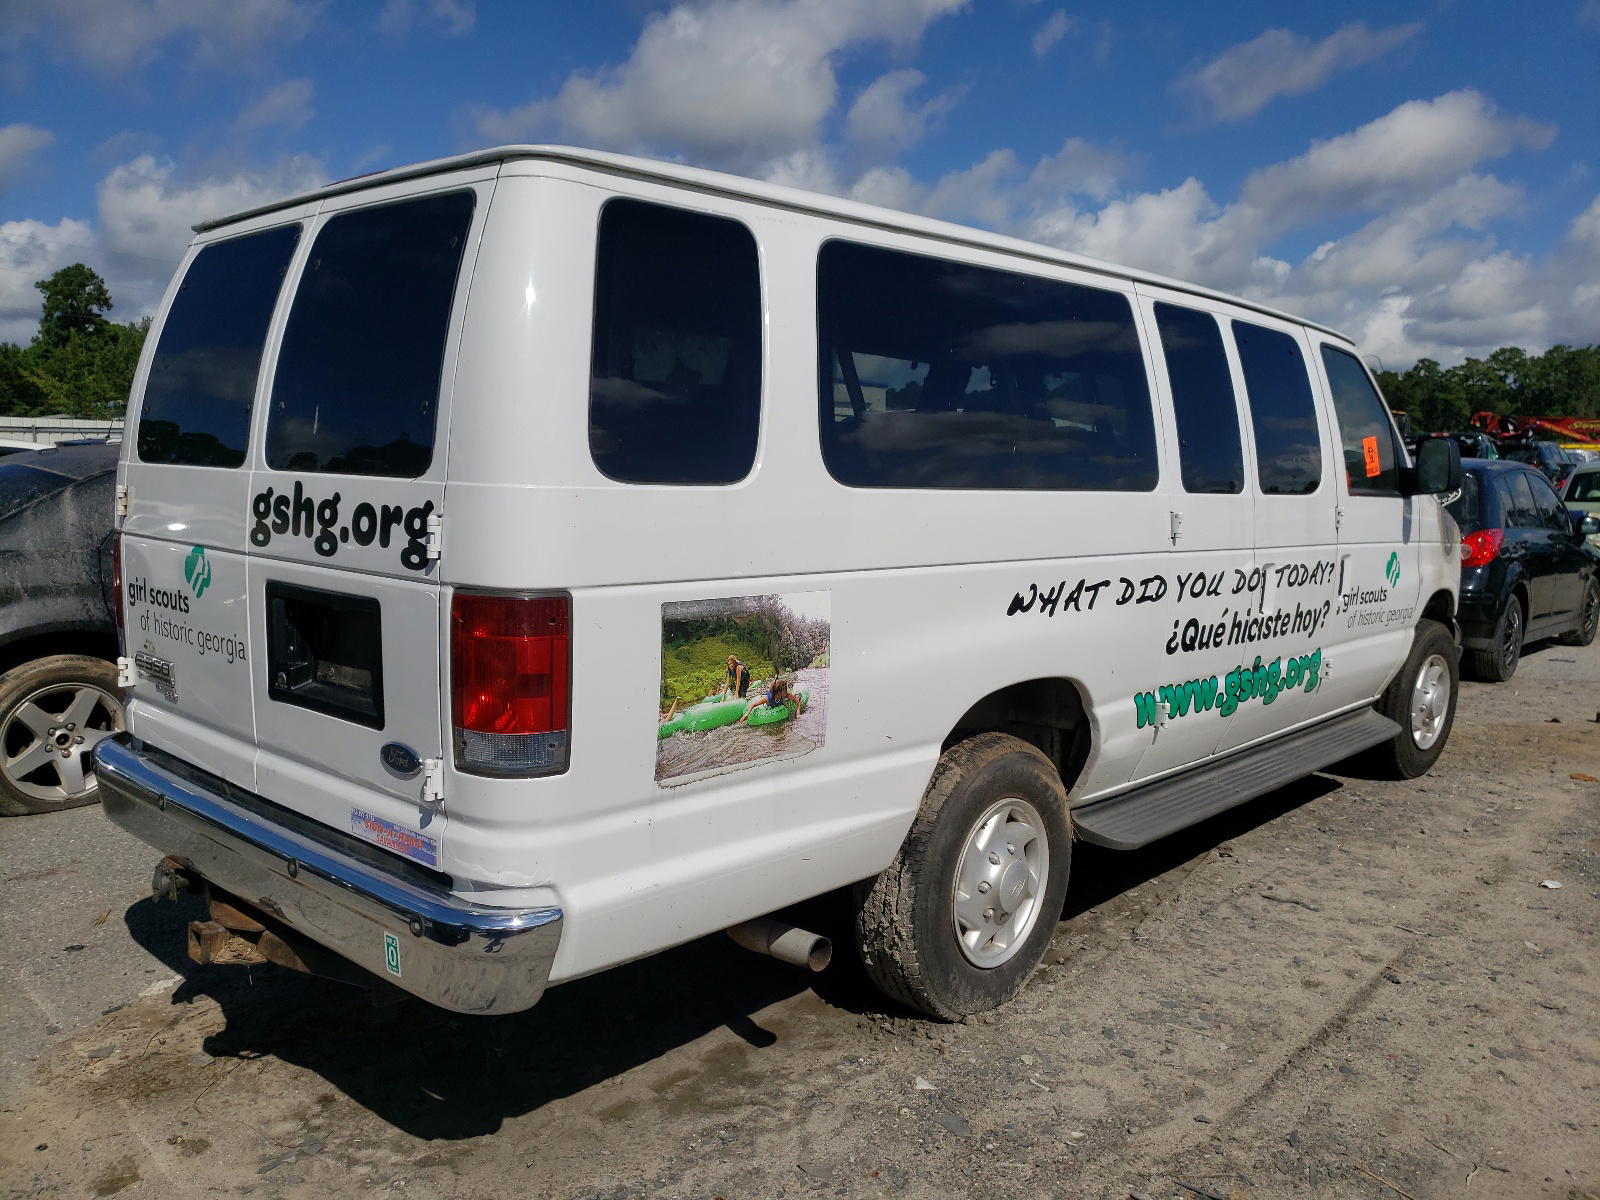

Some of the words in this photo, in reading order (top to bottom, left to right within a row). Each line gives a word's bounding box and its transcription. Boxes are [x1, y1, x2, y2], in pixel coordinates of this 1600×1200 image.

[250, 481, 434, 571] gshg.org
[128, 577, 147, 606] girl
[149, 587, 190, 613] scouts
[1006, 579, 1111, 617] WHAT
[1115, 575, 1168, 605] DID
[1176, 571, 1225, 603] YOU
[1275, 560, 1335, 588] TODAY?
[1342, 585, 1360, 613] girl
[1360, 586, 1387, 605] scouts
[140, 609, 150, 632] of
[153, 611, 194, 645] historic
[197, 631, 247, 664] georgia
[1227, 608, 1291, 646] hiciste
[1291, 600, 1331, 639] hoy?
[1347, 609, 1358, 629] of
[1358, 606, 1385, 627] historic
[1134, 647, 1322, 729] www.gshg.org
